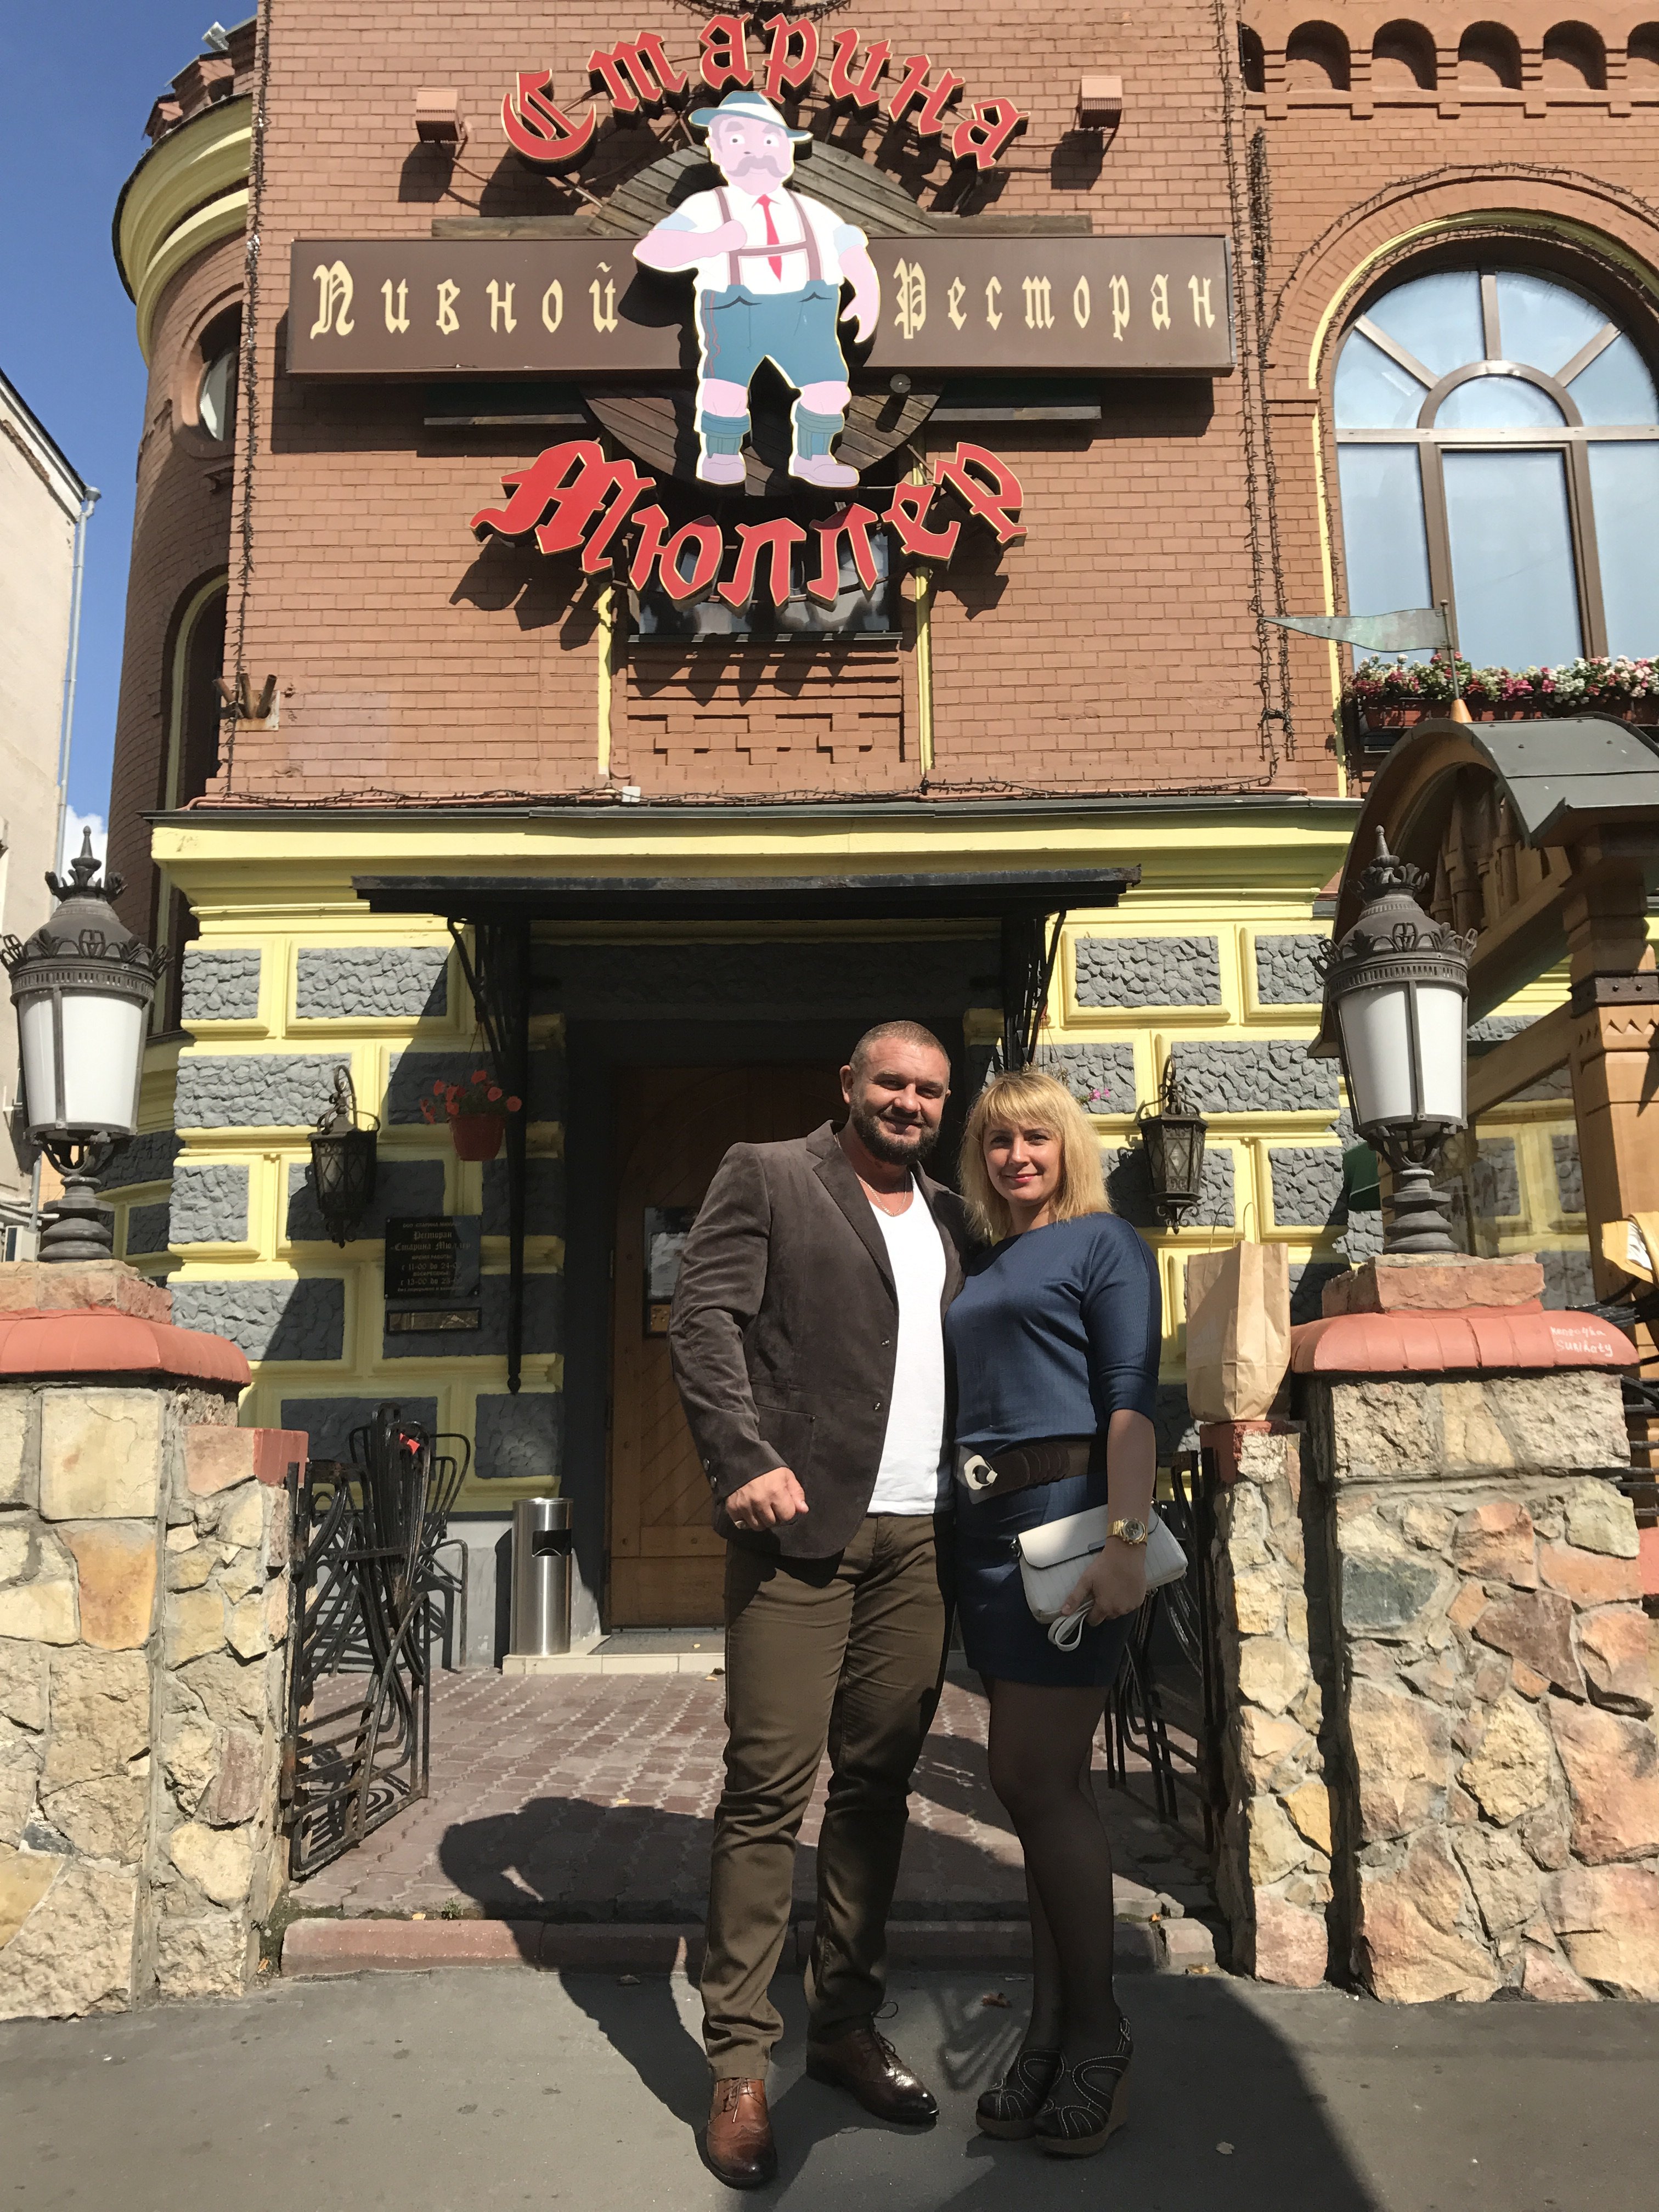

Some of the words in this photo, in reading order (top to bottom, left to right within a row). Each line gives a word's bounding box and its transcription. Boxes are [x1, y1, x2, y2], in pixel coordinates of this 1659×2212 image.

[500, 12, 1030, 170] Старина
[310, 260, 618, 339] Пивной
[894, 258, 1215, 341] Ресторан
[470, 440, 1029, 607] Мюллер
[394, 1242, 432, 1251] Старина
[414, 1231, 452, 1240] Ресторан
